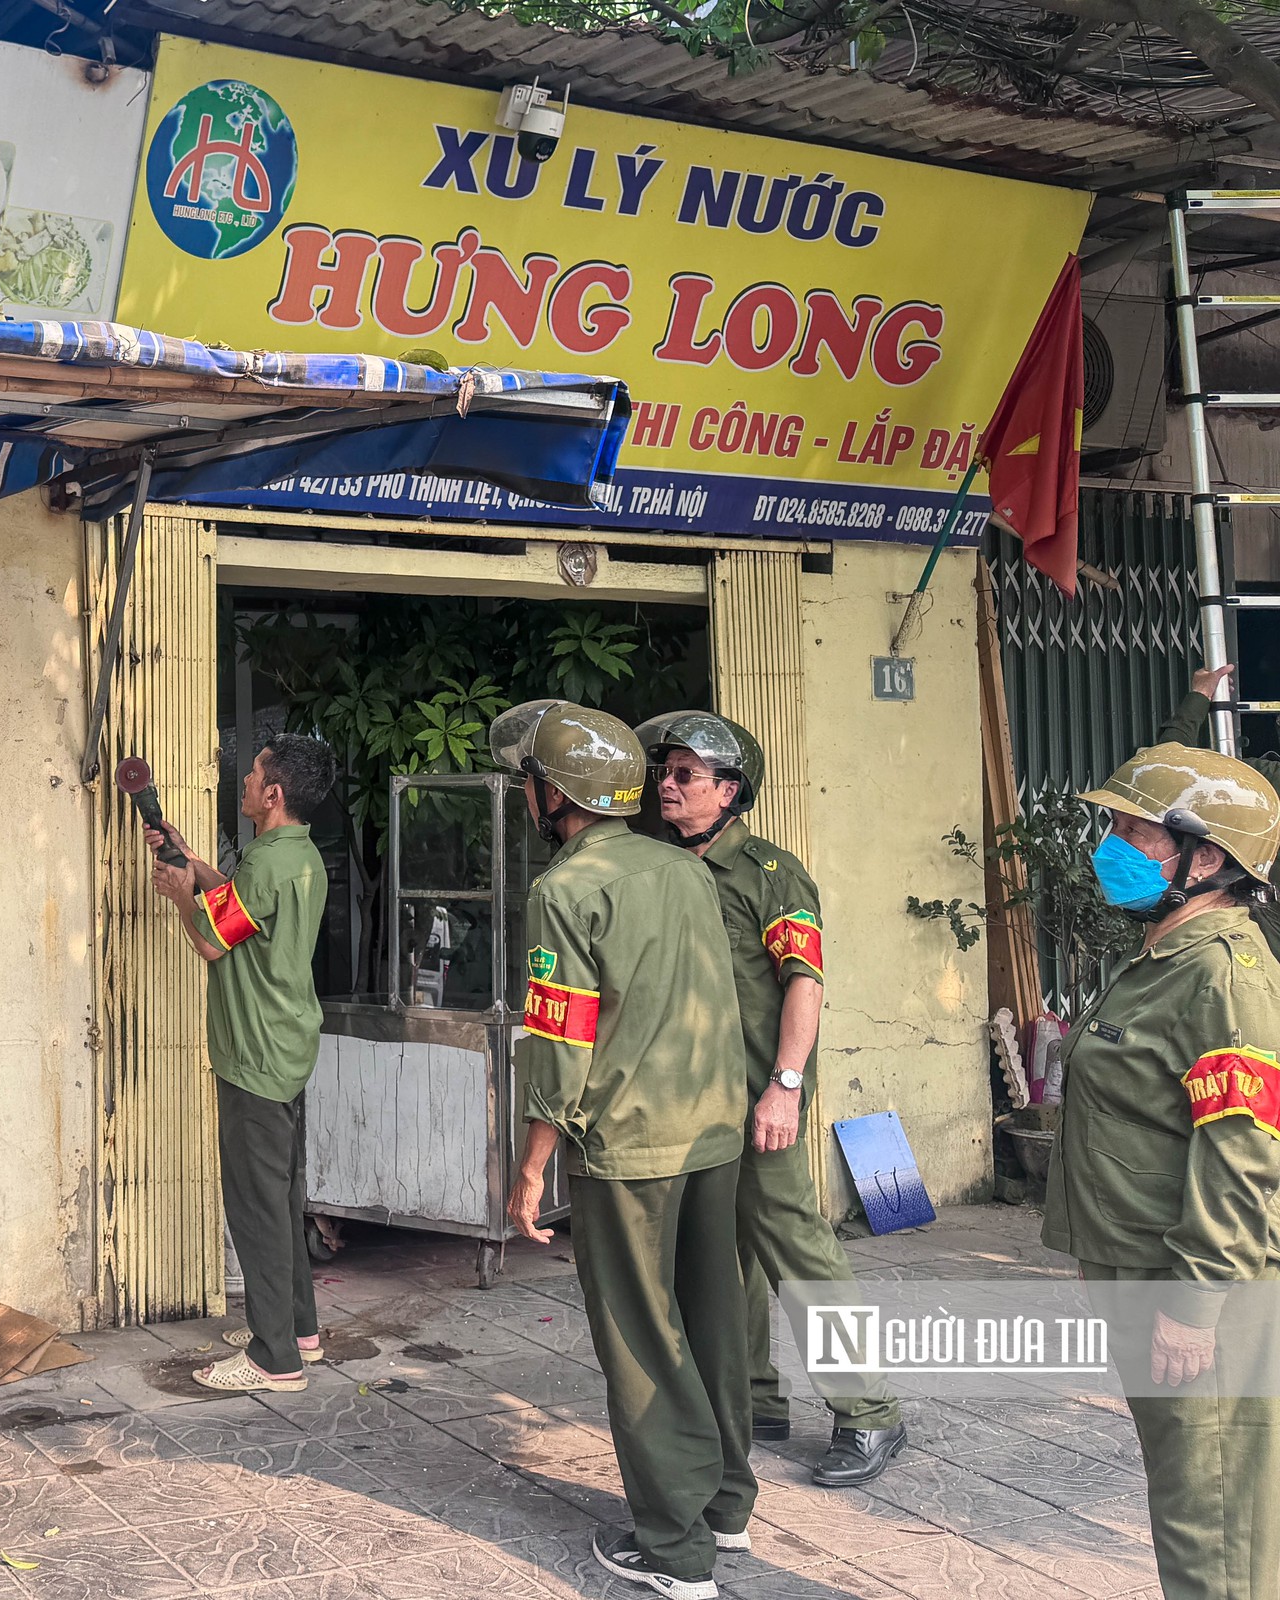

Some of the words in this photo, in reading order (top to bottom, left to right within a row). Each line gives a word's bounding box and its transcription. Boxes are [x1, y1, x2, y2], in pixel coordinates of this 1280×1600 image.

[241, 215, 257, 228] LTD
[561, 144, 667, 216] LÝ
[677, 164, 887, 249] NƯỚC
[266, 222, 632, 355] HƯNG
[653, 271, 945, 386] LONG
[630, 401, 682, 449] THI
[688, 401, 806, 460] CÔNG
[837, 406, 915, 466] LẮP
[920, 422, 987, 481] ĐẶ
[409, 475, 461, 508] THỊNH
[629, 483, 675, 516] TP.HÀ
[675, 485, 709, 523] NỘI
[753, 495, 777, 521] ĐT
[776, 497, 886, 529] 024.8585.8268
